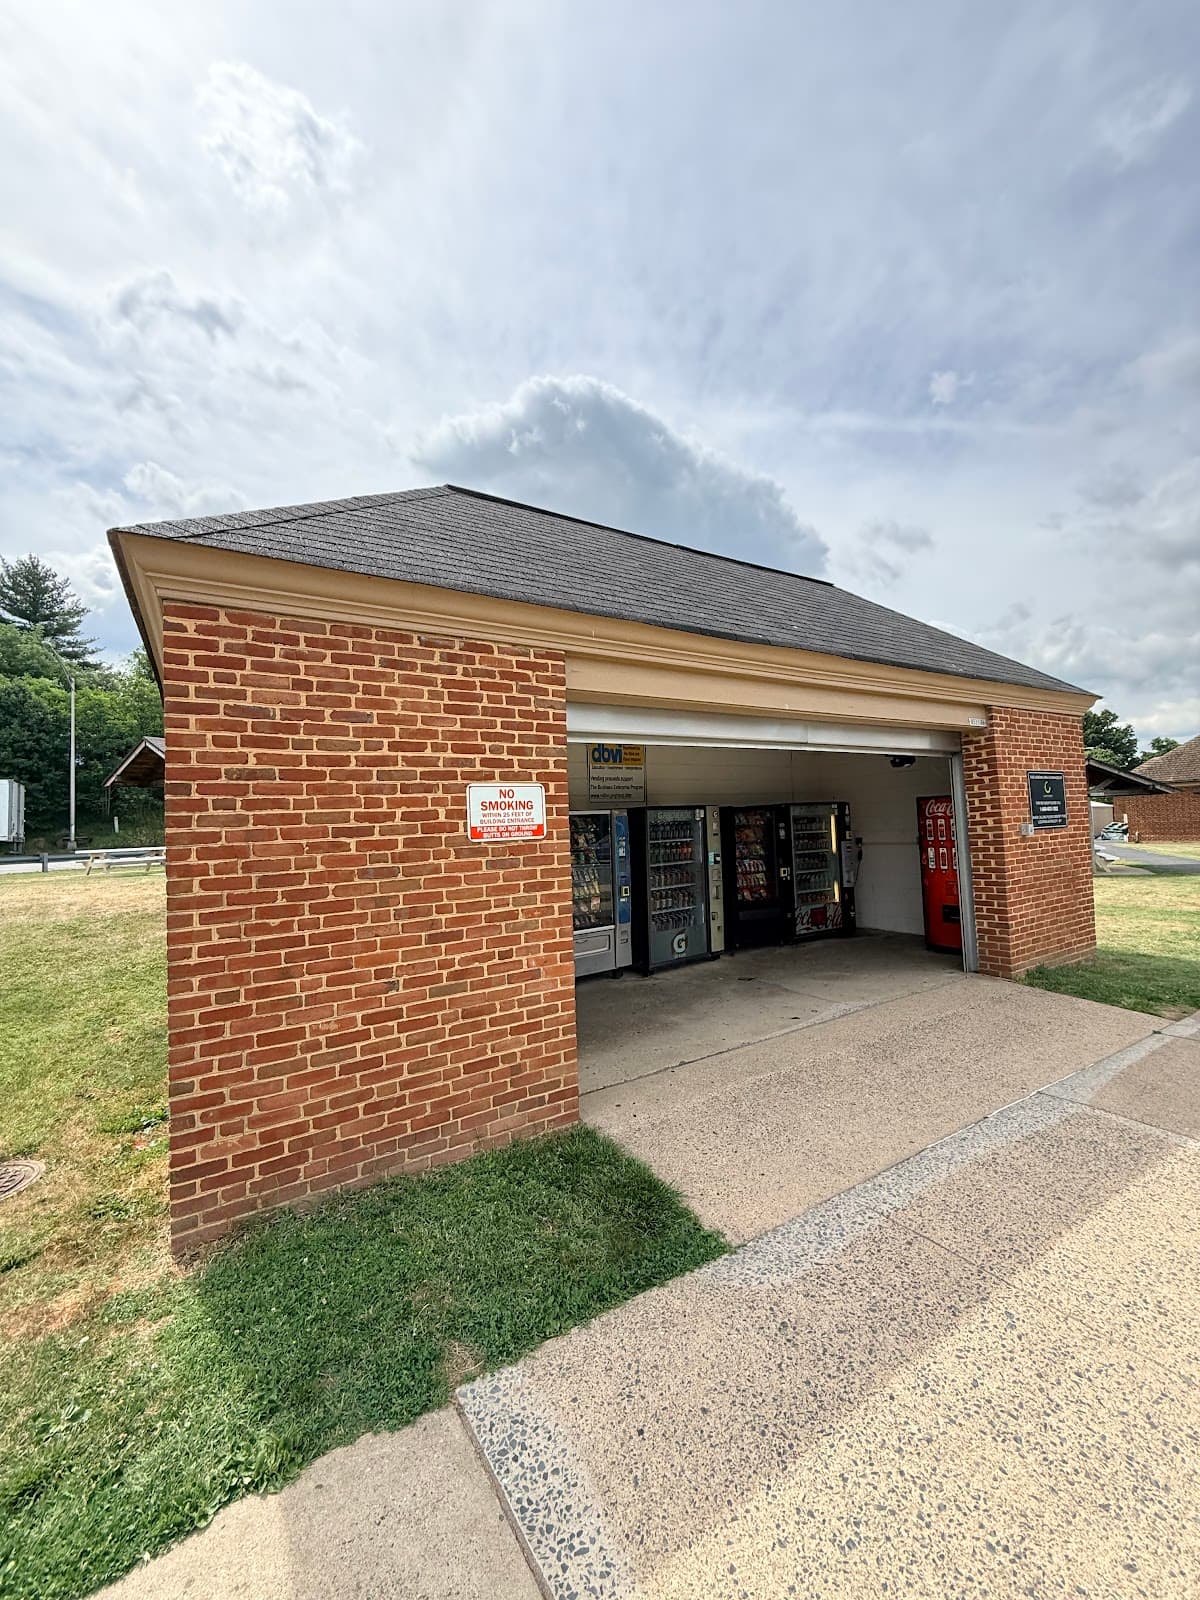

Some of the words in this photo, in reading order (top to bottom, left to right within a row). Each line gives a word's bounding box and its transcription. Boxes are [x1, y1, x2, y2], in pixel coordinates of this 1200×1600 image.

[592, 743, 623, 763] dbvi
[499, 789, 515, 799] NO
[480, 801, 534, 811] SMOKING
[672, 932, 688, 953] G
